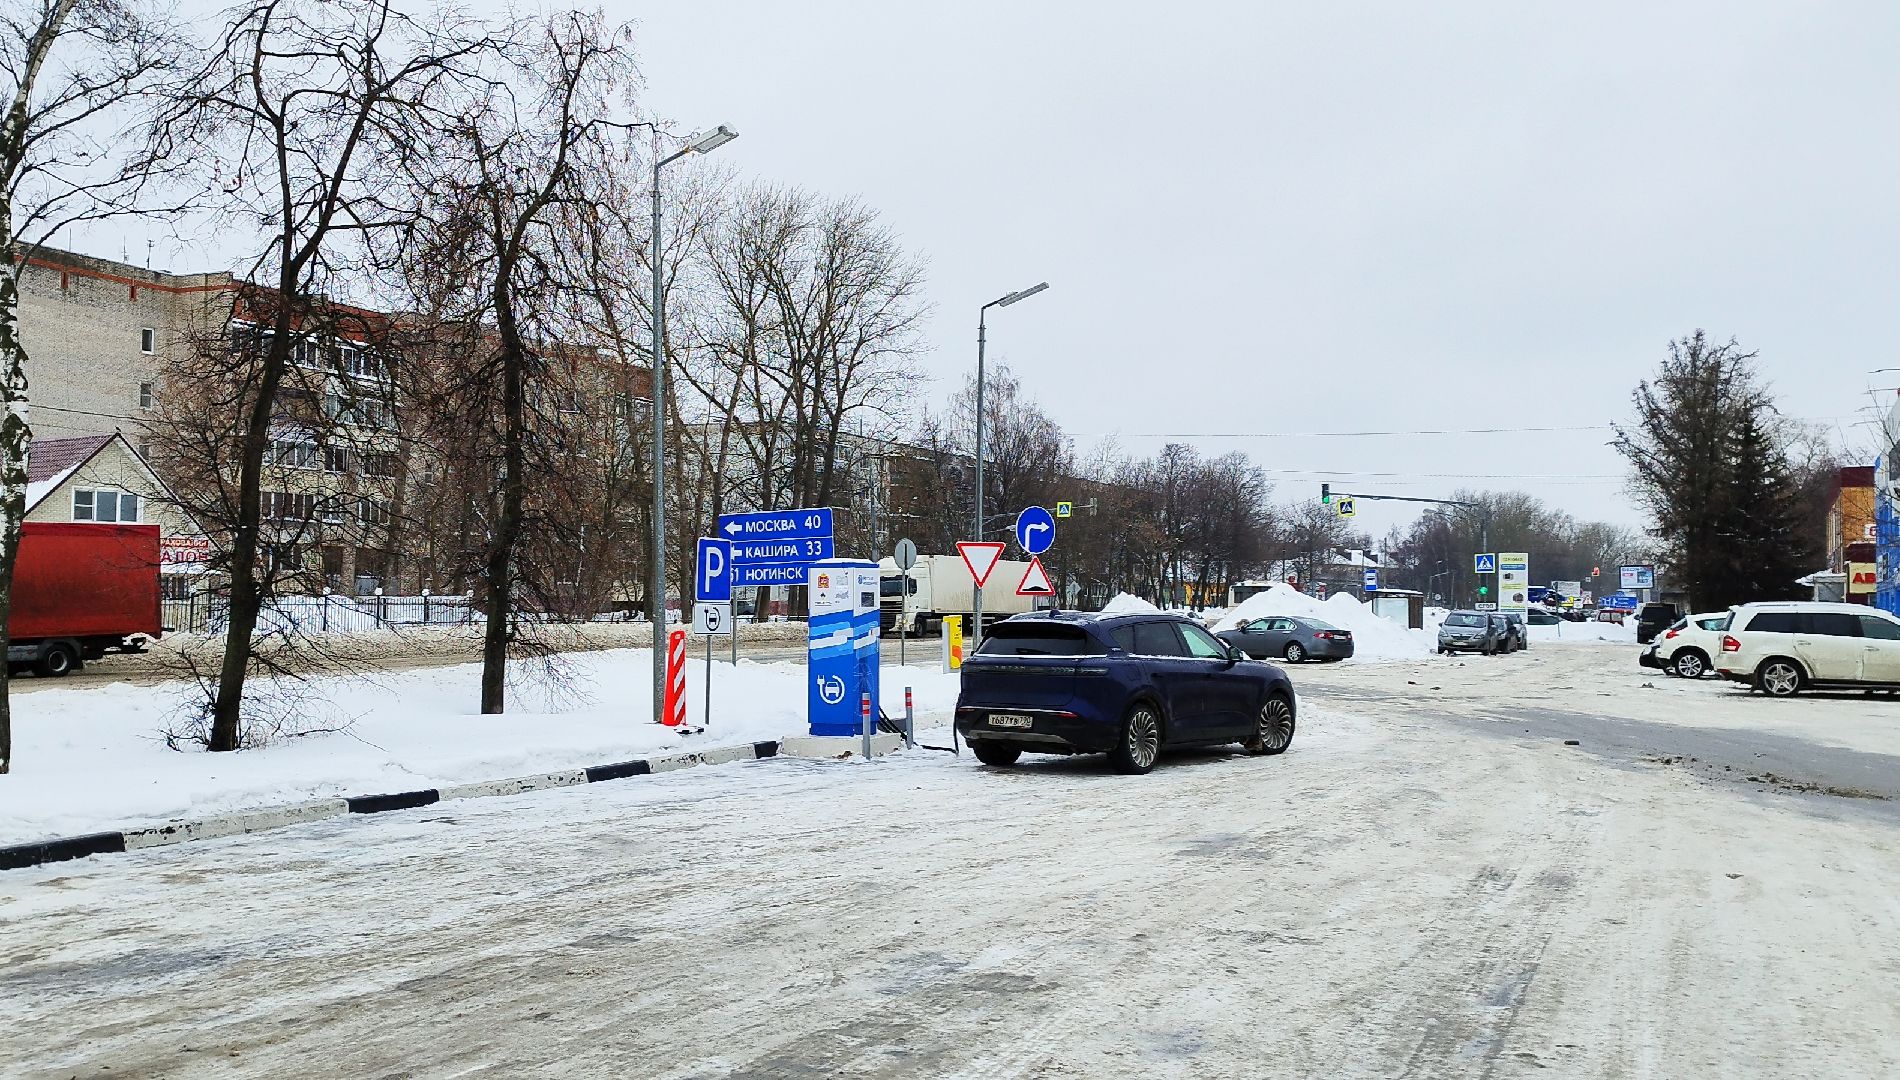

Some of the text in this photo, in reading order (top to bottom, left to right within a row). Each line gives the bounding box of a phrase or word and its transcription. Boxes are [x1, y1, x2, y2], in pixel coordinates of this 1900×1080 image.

[745, 515, 821, 533] МОСКВА 40
[745, 540, 822, 559] КАШИРА 33
[704, 546, 724, 593] P
[745, 566, 804, 581] НОГИНСК
